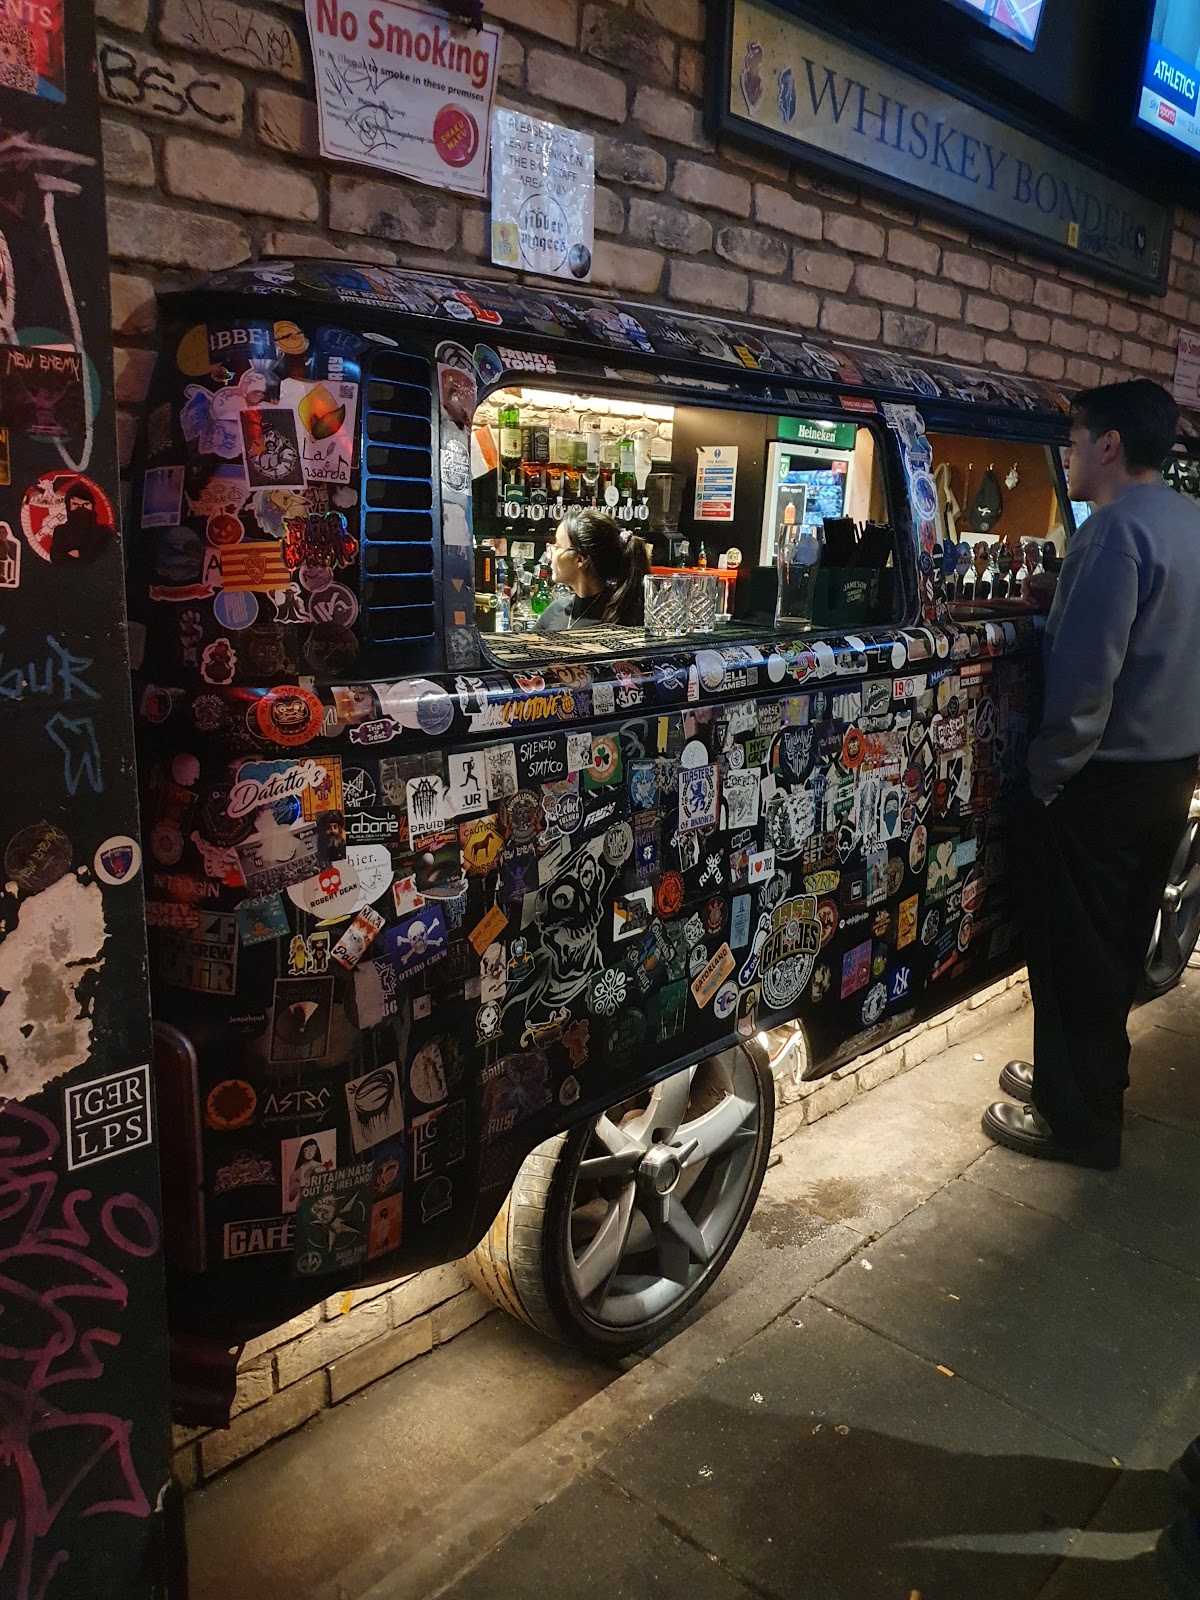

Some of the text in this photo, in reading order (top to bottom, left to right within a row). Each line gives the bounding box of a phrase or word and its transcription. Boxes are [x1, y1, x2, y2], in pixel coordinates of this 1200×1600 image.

[316, 0, 358, 42] No
[368, 9, 490, 89] Smoking
[380, 68, 411, 84] smoke
[412, 77, 421, 86] in
[423, 78, 446, 92] these
[447, 87, 484, 103] premises
[1153, 59, 1196, 100] ATHLETICS
[1160, 104, 1176, 120] sports
[802, 57, 1008, 191] WHISKEY
[509, 153, 527, 169] THE
[552, 168, 578, 183] STAFF
[798, 425, 836, 443] Heineken
[843, 581, 867, 593] JAMESON
[367, 722, 385, 731] Trick
[750, 740, 766, 750] NYC
[528, 756, 564, 778] STATICO
[681, 766, 715, 785] MASTERS
[230, 763, 322, 813] Datatto's
[555, 797, 583, 819] Rebel
[410, 820, 445, 833] DRUID
[463, 820, 498, 838] CAUTION
[680, 819, 689, 831] OF
[805, 834, 823, 851] JET
[802, 848, 823, 864] SET
[310, 883, 359, 908] ROBERT DEAN
[399, 963, 425, 982] OTERO
[694, 948, 728, 993] GATORLAND
[78, 1115, 143, 1160] LPS
[303, 1182, 320, 1198] OUT
[322, 1180, 336, 1195] OF
